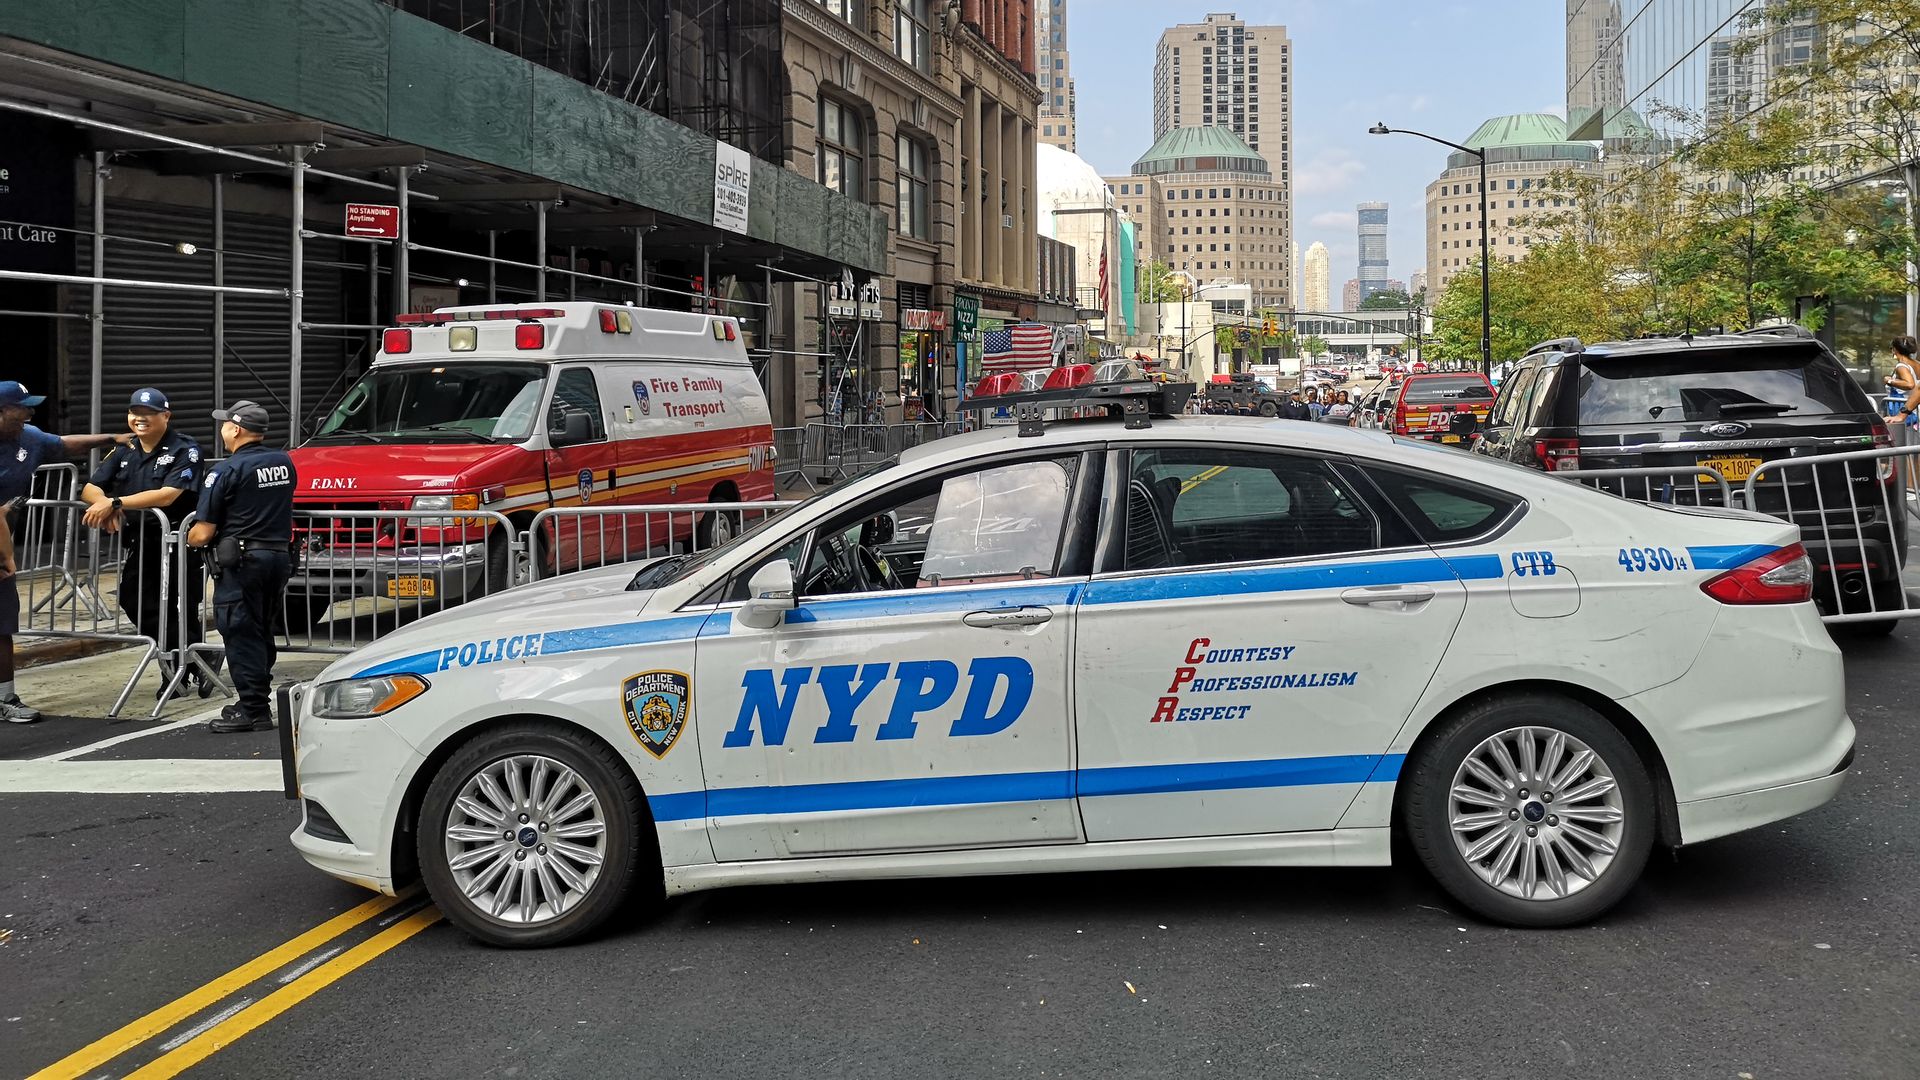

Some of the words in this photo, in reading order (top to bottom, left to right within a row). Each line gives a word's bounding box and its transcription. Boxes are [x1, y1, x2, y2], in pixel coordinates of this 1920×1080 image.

[718, 160, 748, 189] SPIRE
[360, 208, 390, 216] STANDING
[18, 224, 57, 243] Care
[957, 310, 974, 324] PIZZA
[650, 378, 679, 394] Fire
[682, 377, 723, 393] Family
[663, 400, 726, 418] Transport
[1717, 422, 1739, 434] Ford
[256, 465, 289, 483] NYPD
[310, 478, 358, 489] F.D.N.Y.
[1511, 551, 1558, 577] CTB
[1618, 547, 1674, 573] 4930
[1674, 557, 1688, 571] 14
[439, 633, 542, 672] POLICE
[637, 673, 674, 687] POLICE
[625, 682, 686, 702] DEPARTMENT
[722, 656, 1034, 748] NYPD
[627, 711, 642, 731] CITY
[639, 733, 651, 744] OF
[663, 727, 678, 746] NEW
[675, 701, 687, 724] YORK
